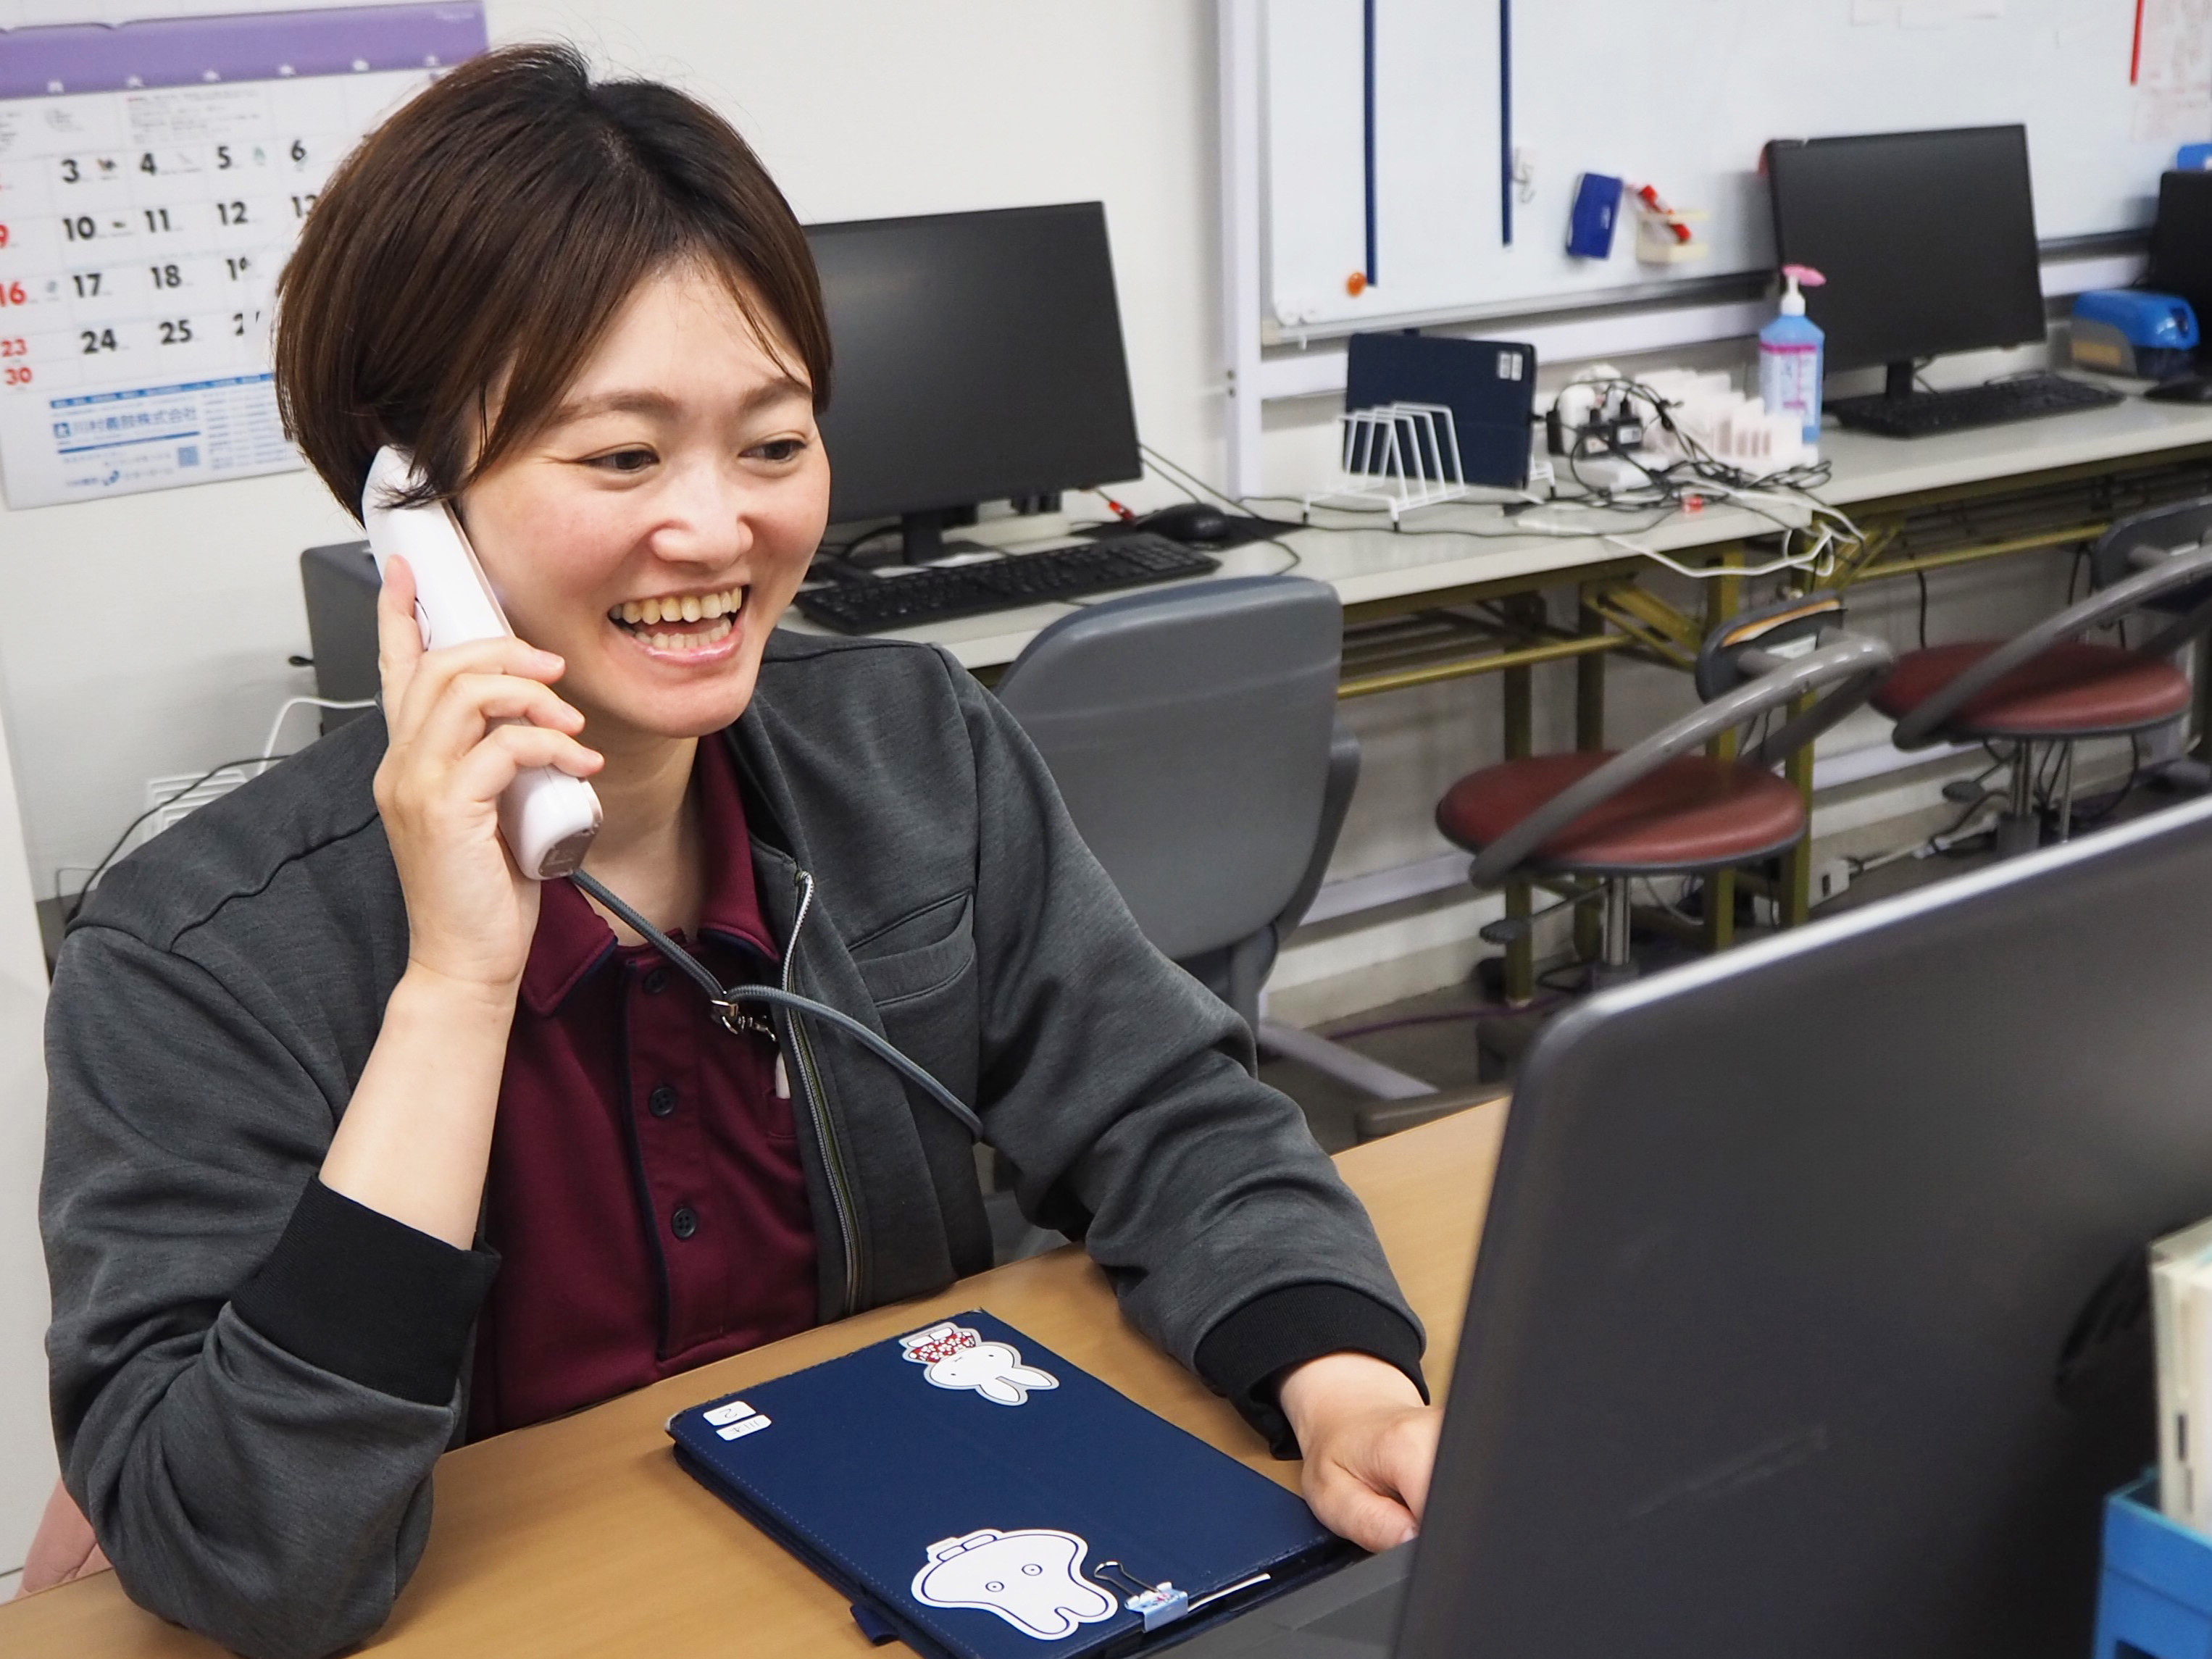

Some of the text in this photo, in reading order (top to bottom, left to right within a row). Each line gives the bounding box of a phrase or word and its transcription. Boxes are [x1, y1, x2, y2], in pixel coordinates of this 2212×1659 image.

[62, 141, 306, 184] 3 4 5 6
[62, 216, 96, 241] 10
[145, 209, 170, 233] 11
[217, 201, 248, 226] 12
[0, 281, 26, 307] 16
[73, 272, 101, 297] 17
[150, 264, 181, 288] 18
[1, 338, 27, 357] 23
[81, 330, 117, 355] 24
[159, 319, 192, 345] 25
[5, 367, 33, 386] 30
[719, 1408, 738, 1419] 2
